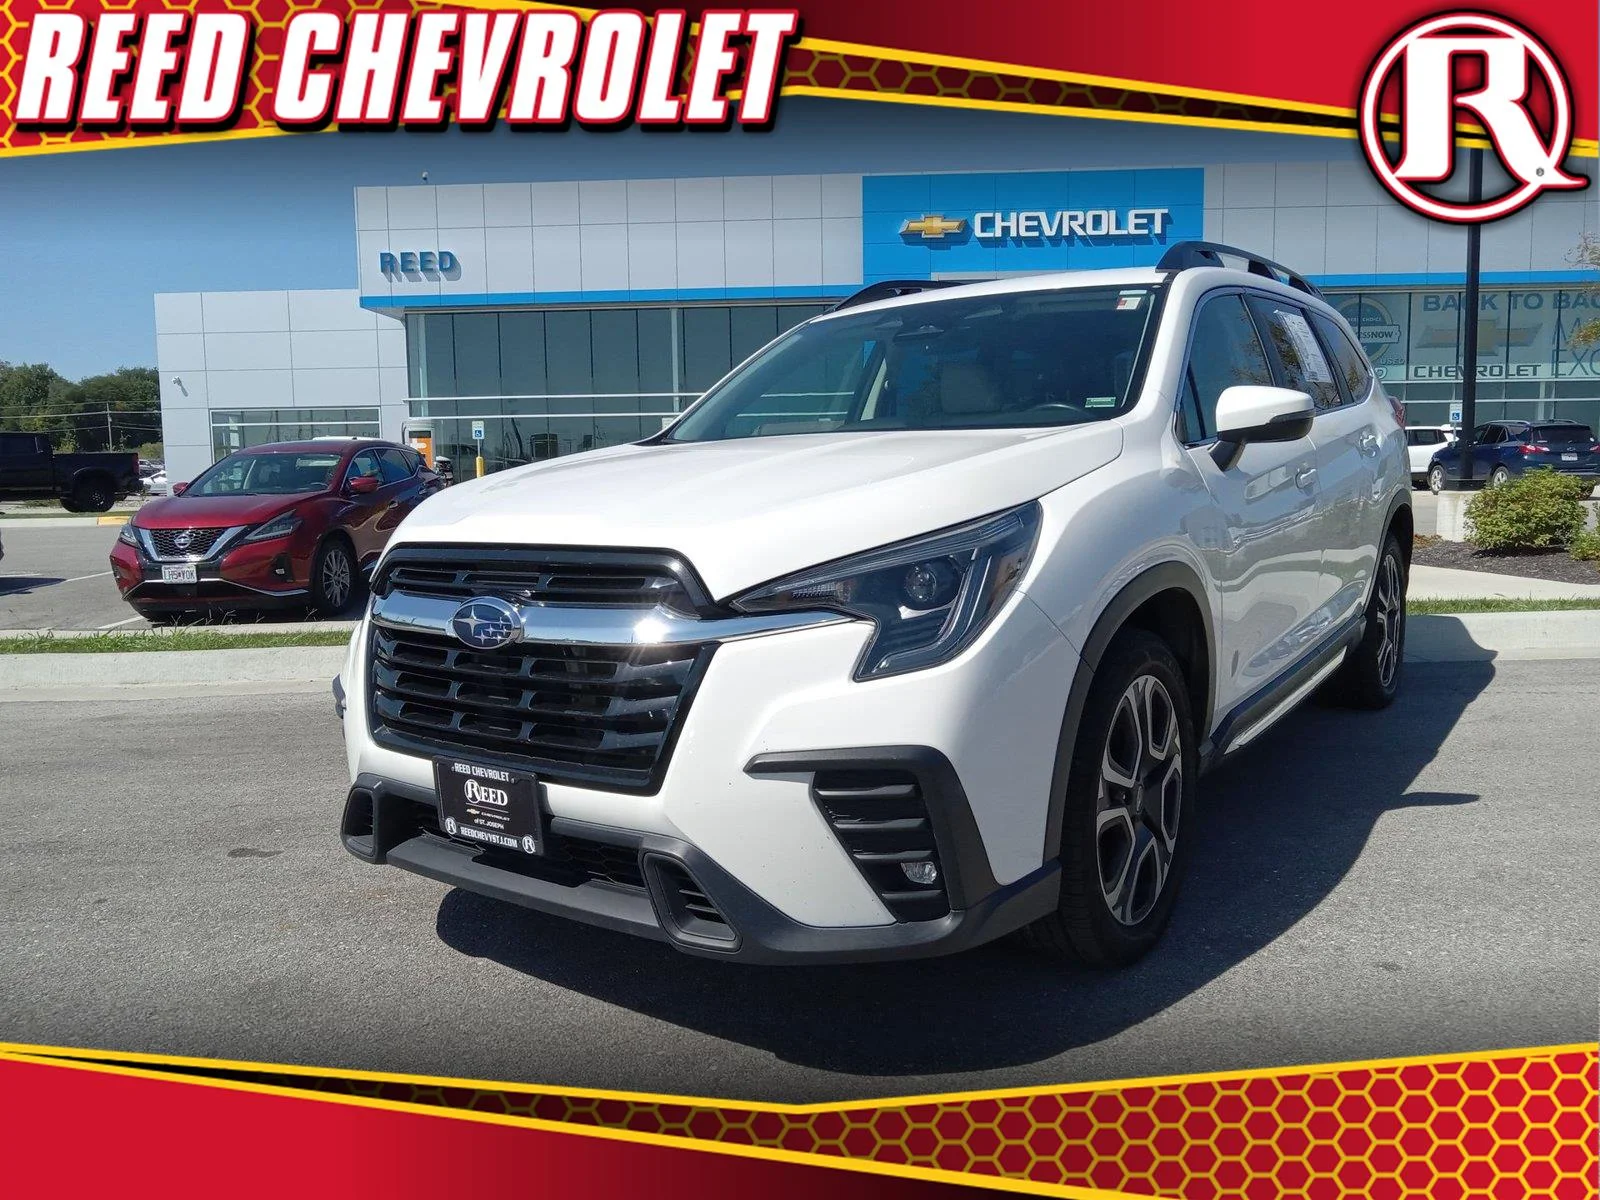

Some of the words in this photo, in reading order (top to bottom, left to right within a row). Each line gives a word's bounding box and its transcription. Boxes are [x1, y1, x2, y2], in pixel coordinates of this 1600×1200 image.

[973, 208, 1169, 238] CHEVROLET
[379, 250, 452, 273] REED
[1511, 293, 1543, 310] TO
[454, 763, 471, 774] REED
[472, 767, 509, 782] CHEVROLET
[464, 779, 508, 806] REED
